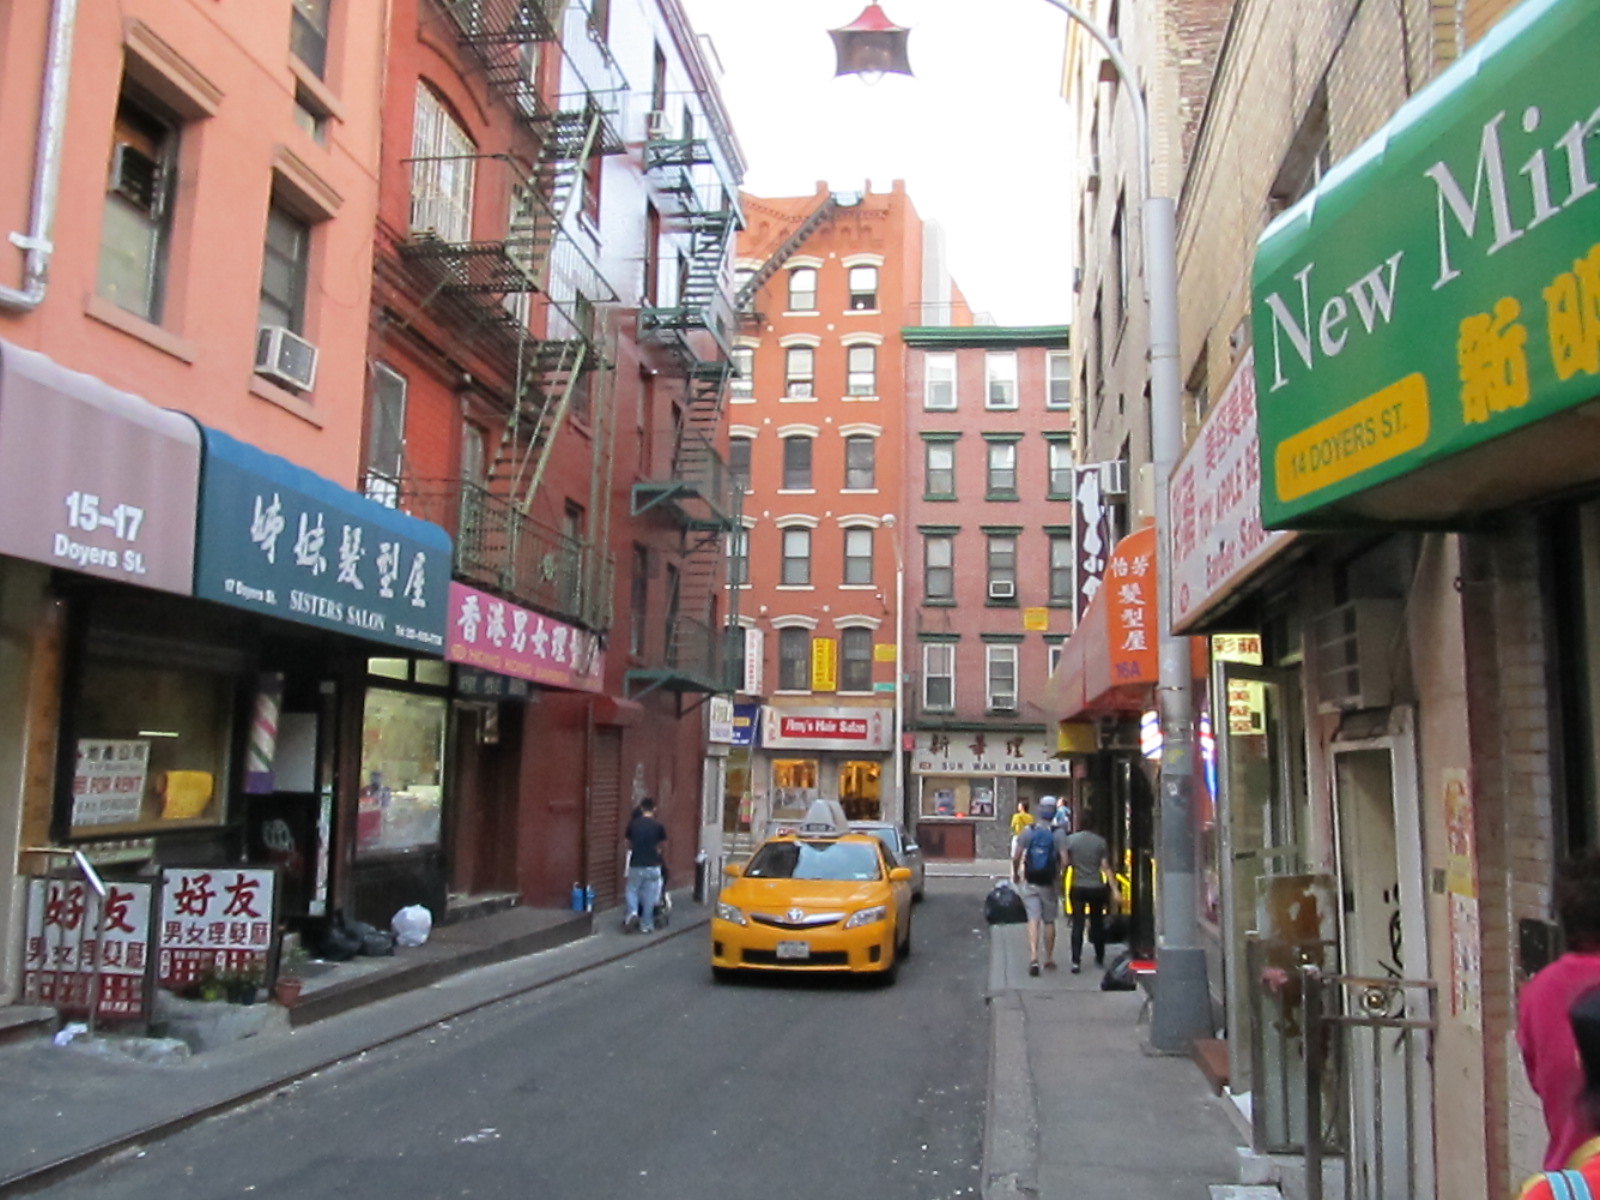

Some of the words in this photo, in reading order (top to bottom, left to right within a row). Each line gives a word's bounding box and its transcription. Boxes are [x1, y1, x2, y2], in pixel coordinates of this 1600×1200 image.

[1264, 250, 1404, 393] New
[1309, 416, 1376, 471] DOYERS
[66, 490, 145, 542] 15-17
[54, 532, 119, 567] Doyers
[122, 549, 147, 574] St.
[289, 588, 344, 623] SISTERS
[346, 605, 387, 632] SALON
[815, 719, 837, 733] Hair
[839, 720, 866, 734] Salon
[928, 732, 1048, 762] 新華理
[973, 762, 996, 772] WAH
[1005, 763, 1051, 773] BARBER
[44, 885, 137, 934] 好友
[173, 872, 263, 919] 好友
